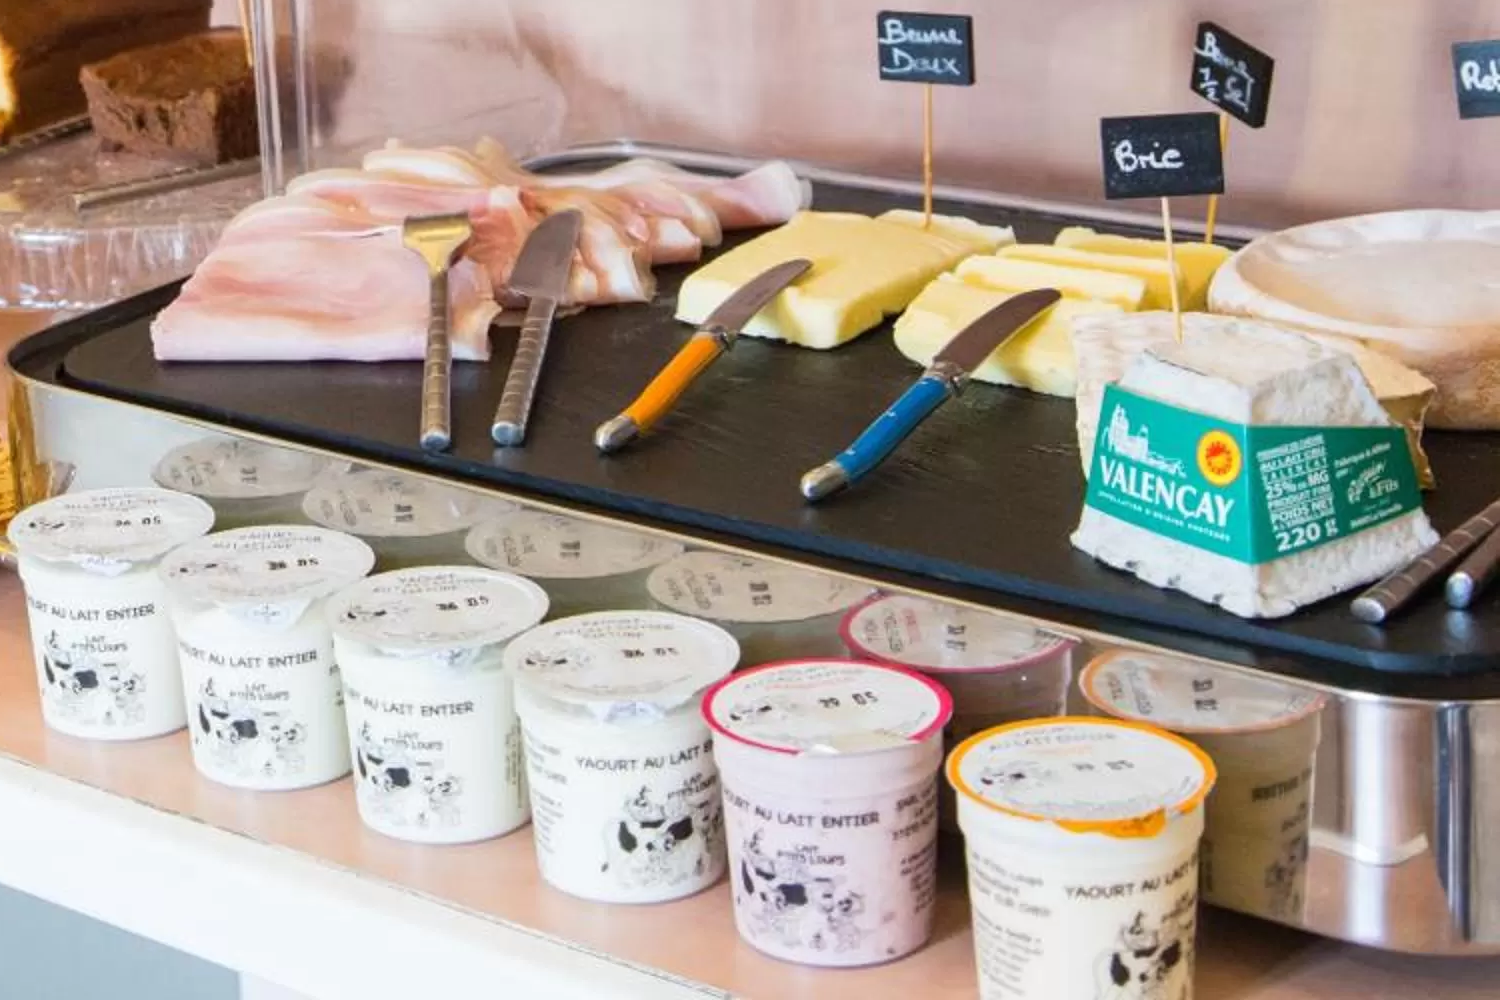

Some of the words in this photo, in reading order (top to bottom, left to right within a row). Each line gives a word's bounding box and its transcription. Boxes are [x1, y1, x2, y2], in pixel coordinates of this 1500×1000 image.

[1113, 139, 1184, 172] Brie
[1100, 455, 1235, 527] VALENÇAY
[1275, 522, 1321, 552] 220
[69, 608, 100, 622] LAIT
[105, 603, 156, 621] ENTIER
[229, 654, 261, 668] LAIT
[267, 650, 318, 669] ENTIER
[383, 701, 414, 715] LAIT
[421, 701, 474, 717] ENTIER
[575, 756, 639, 772] YAOURT
[644, 756, 665, 770] AU
[669, 745, 699, 766] LAIT
[778, 811, 815, 826] LAIT
[821, 811, 880, 829] ENTIER
[1064, 882, 1134, 901] YAOURT
[1140, 876, 1161, 891] AU
